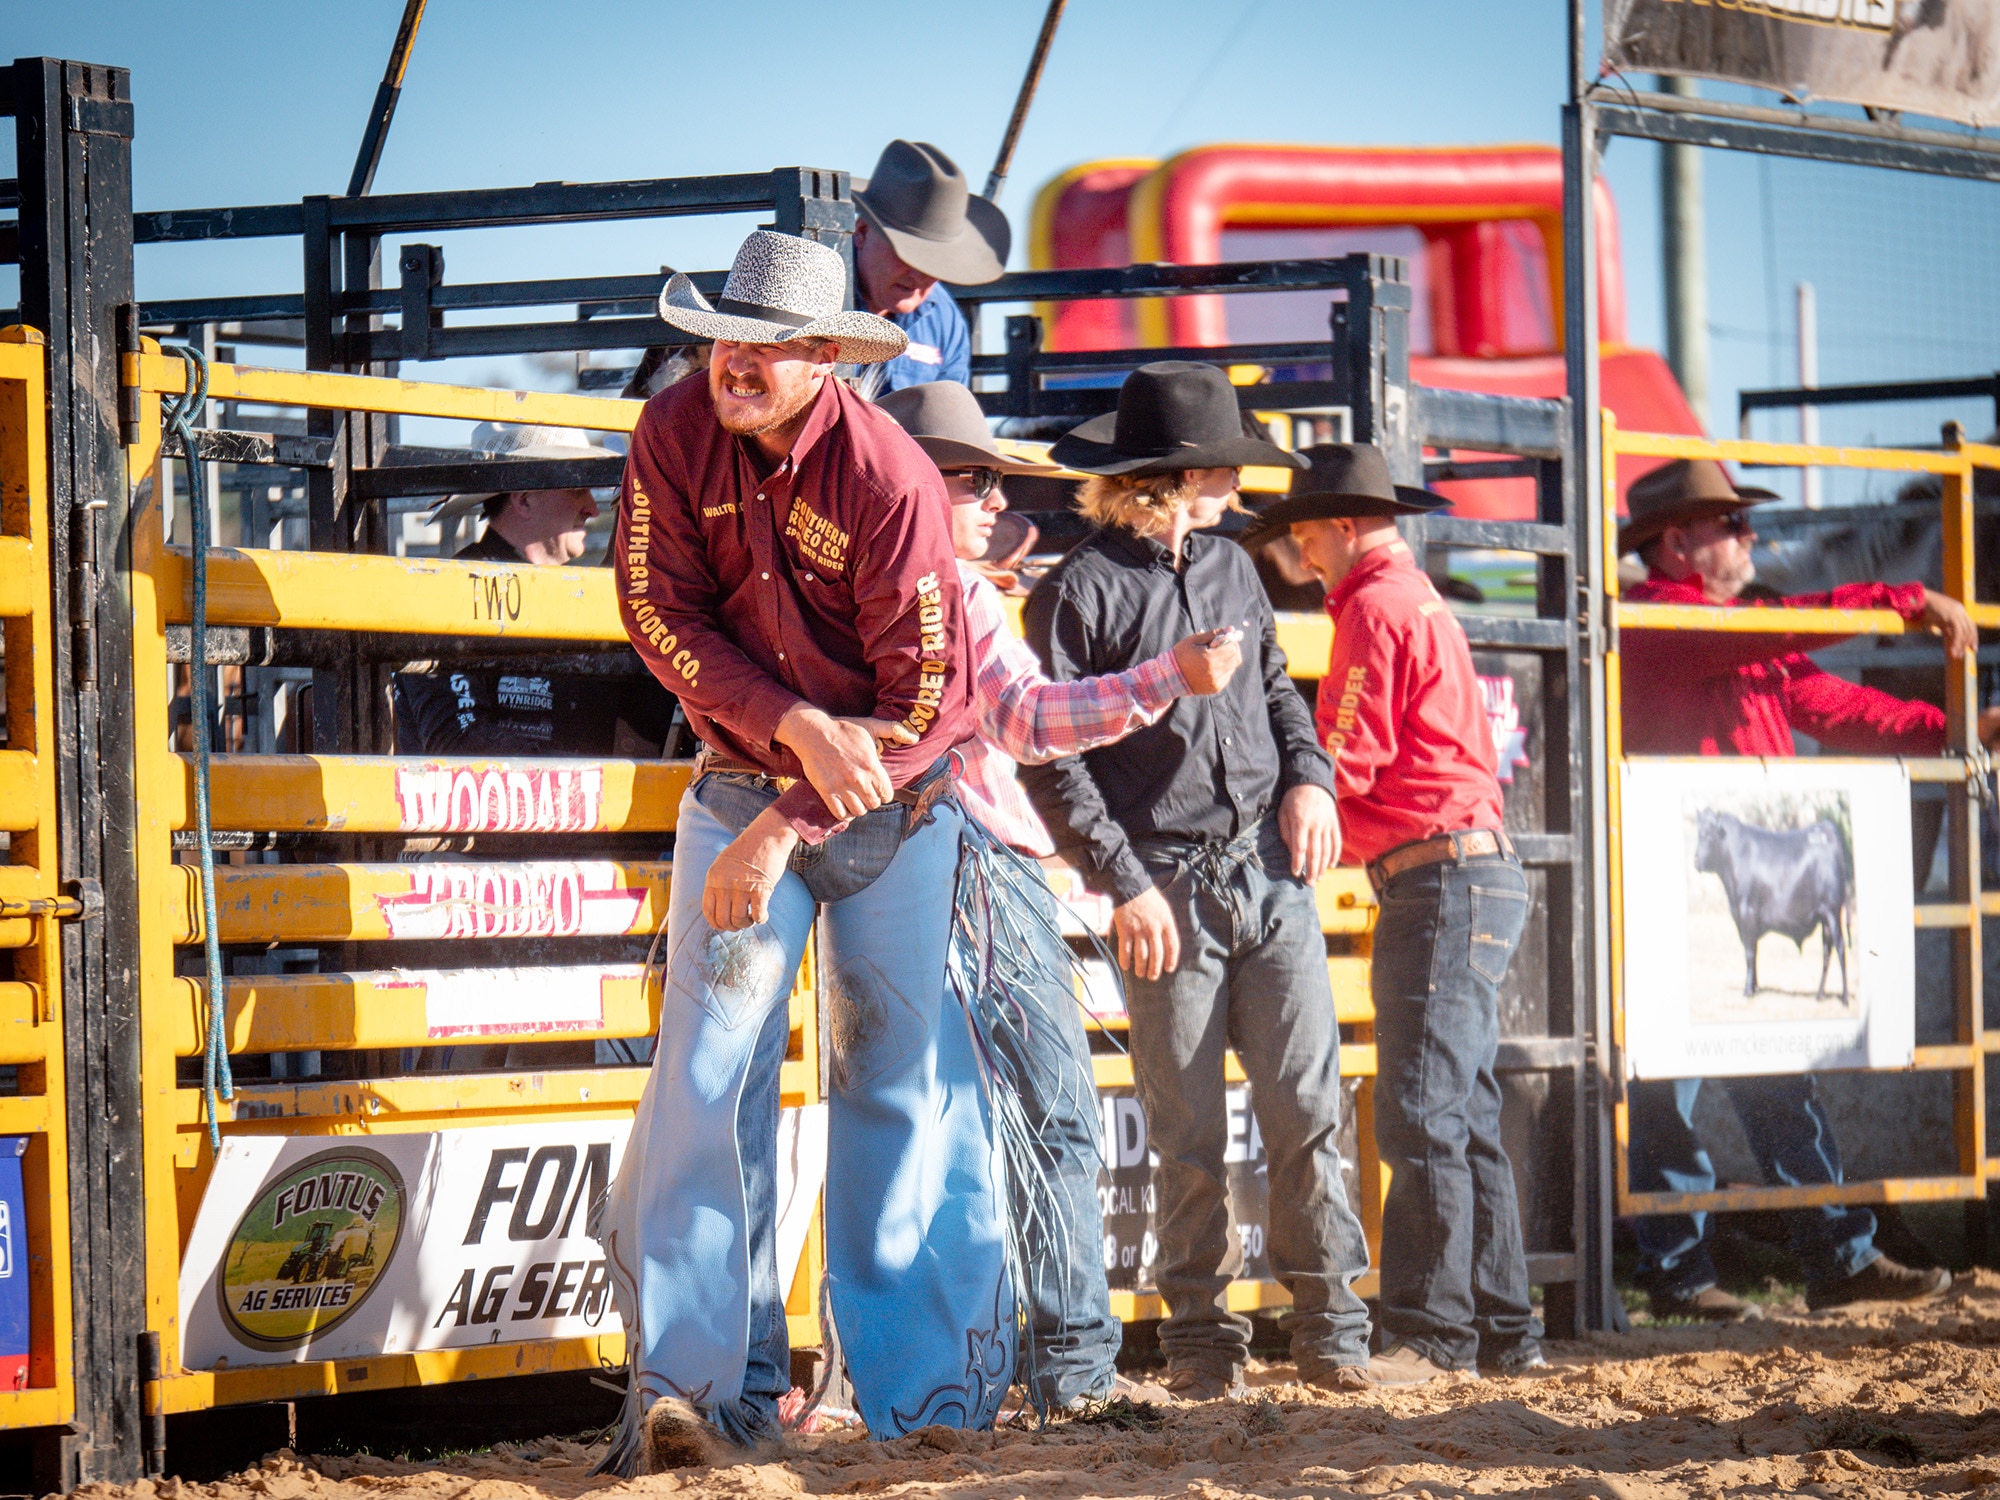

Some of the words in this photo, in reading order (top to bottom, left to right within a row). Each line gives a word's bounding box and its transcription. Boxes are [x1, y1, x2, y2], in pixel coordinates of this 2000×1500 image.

[702, 502, 737, 518] WALTE
[793, 496, 849, 549] SOUTHERN
[817, 556, 845, 572] RIDER
[821, 541, 846, 561] CO.
[468, 572, 522, 621] TWO
[916, 571, 946, 652] RIDER
[671, 650, 700, 688] CO.
[497, 693, 553, 711] WYNRIDGE
[1336, 666, 1367, 730] RIDER
[274, 1171, 387, 1229] FONTUS
[462, 1142, 612, 1246] FON
[1121, 1245, 1137, 1268] or
[238, 1289, 268, 1312] AG
[269, 1283, 354, 1311] SERVICES
[433, 1265, 515, 1328] AG
[511, 1259, 621, 1322] SER
